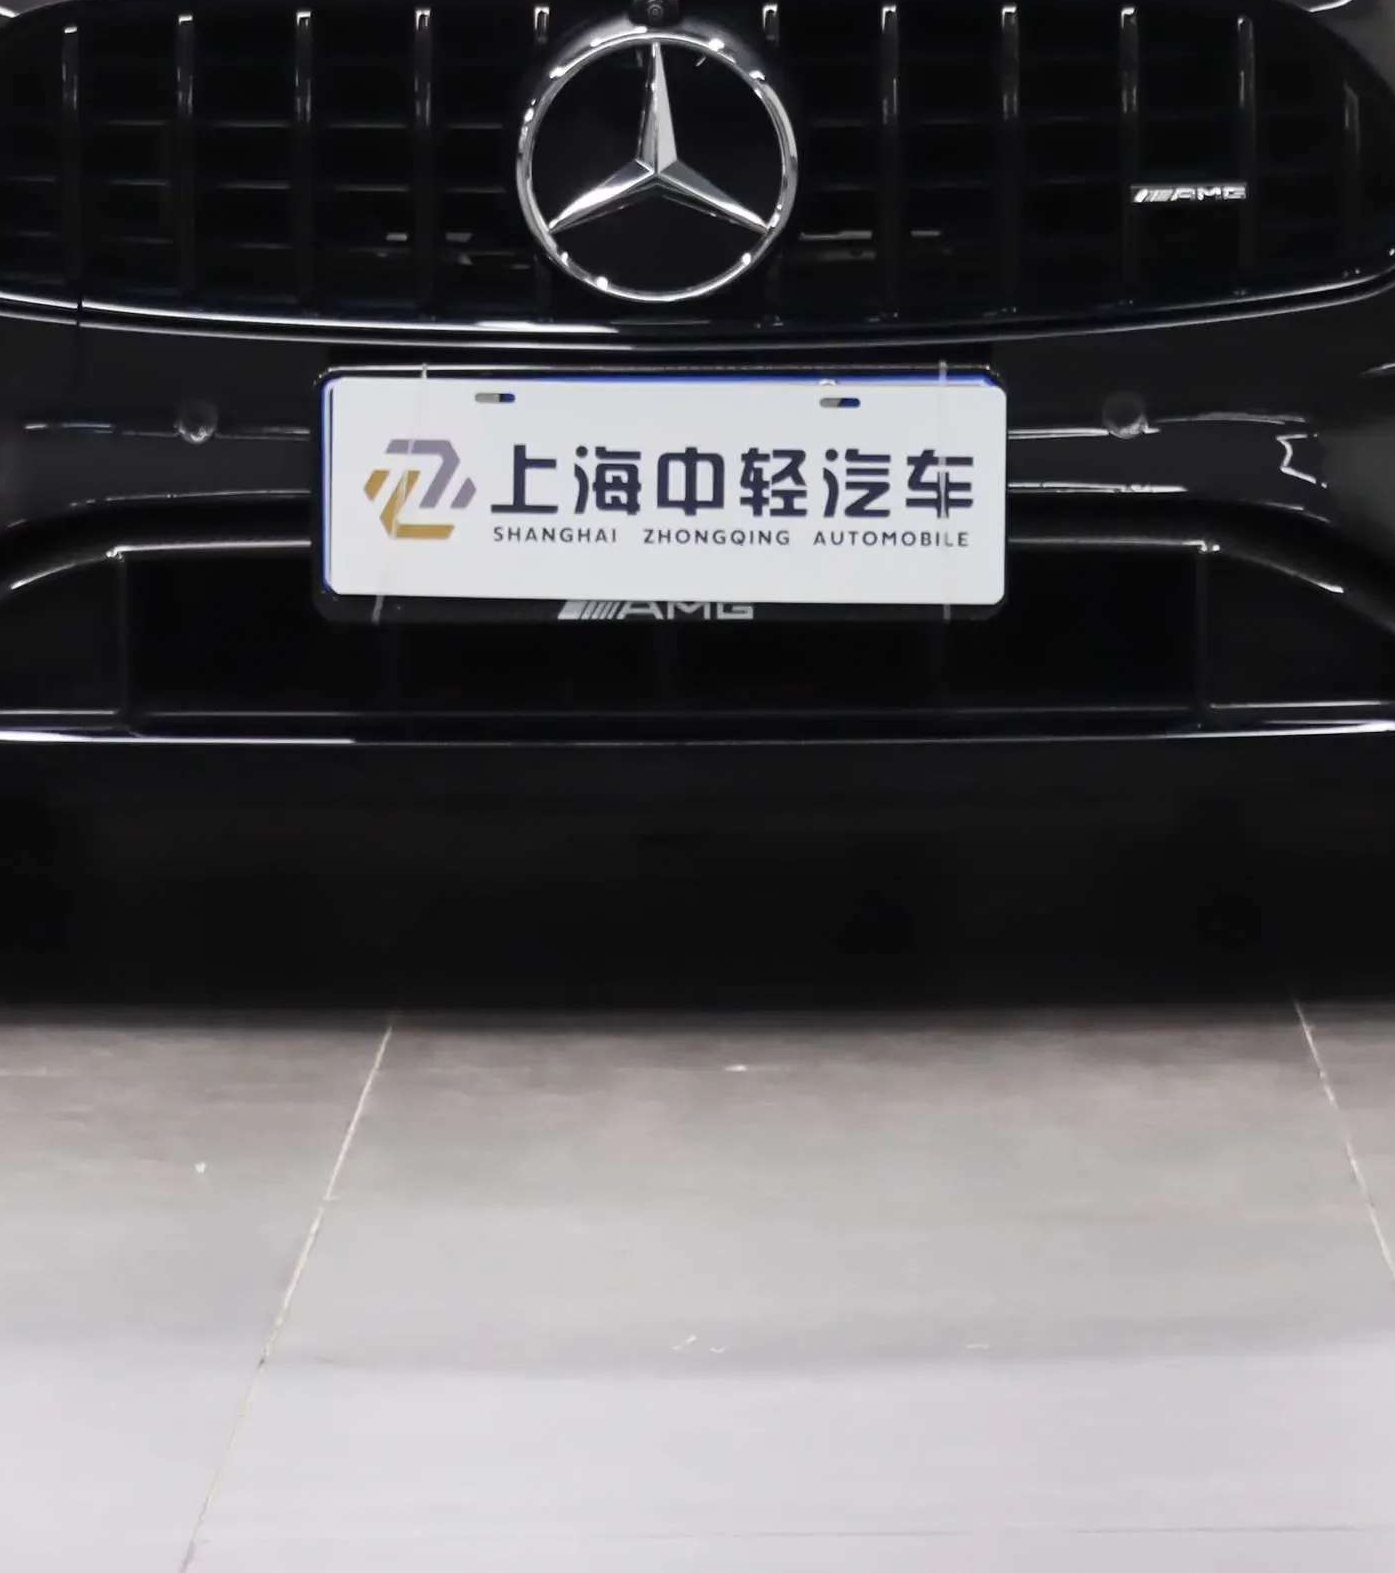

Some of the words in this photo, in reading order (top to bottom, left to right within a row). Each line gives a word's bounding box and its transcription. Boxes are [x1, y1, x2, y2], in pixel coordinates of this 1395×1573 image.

[490, 444, 975, 519] 上海中轻汽车
[492, 526, 617, 544] SHANGHAI
[643, 528, 791, 546] ZHONGQING
[812, 530, 970, 548] AUTOMOBILE
